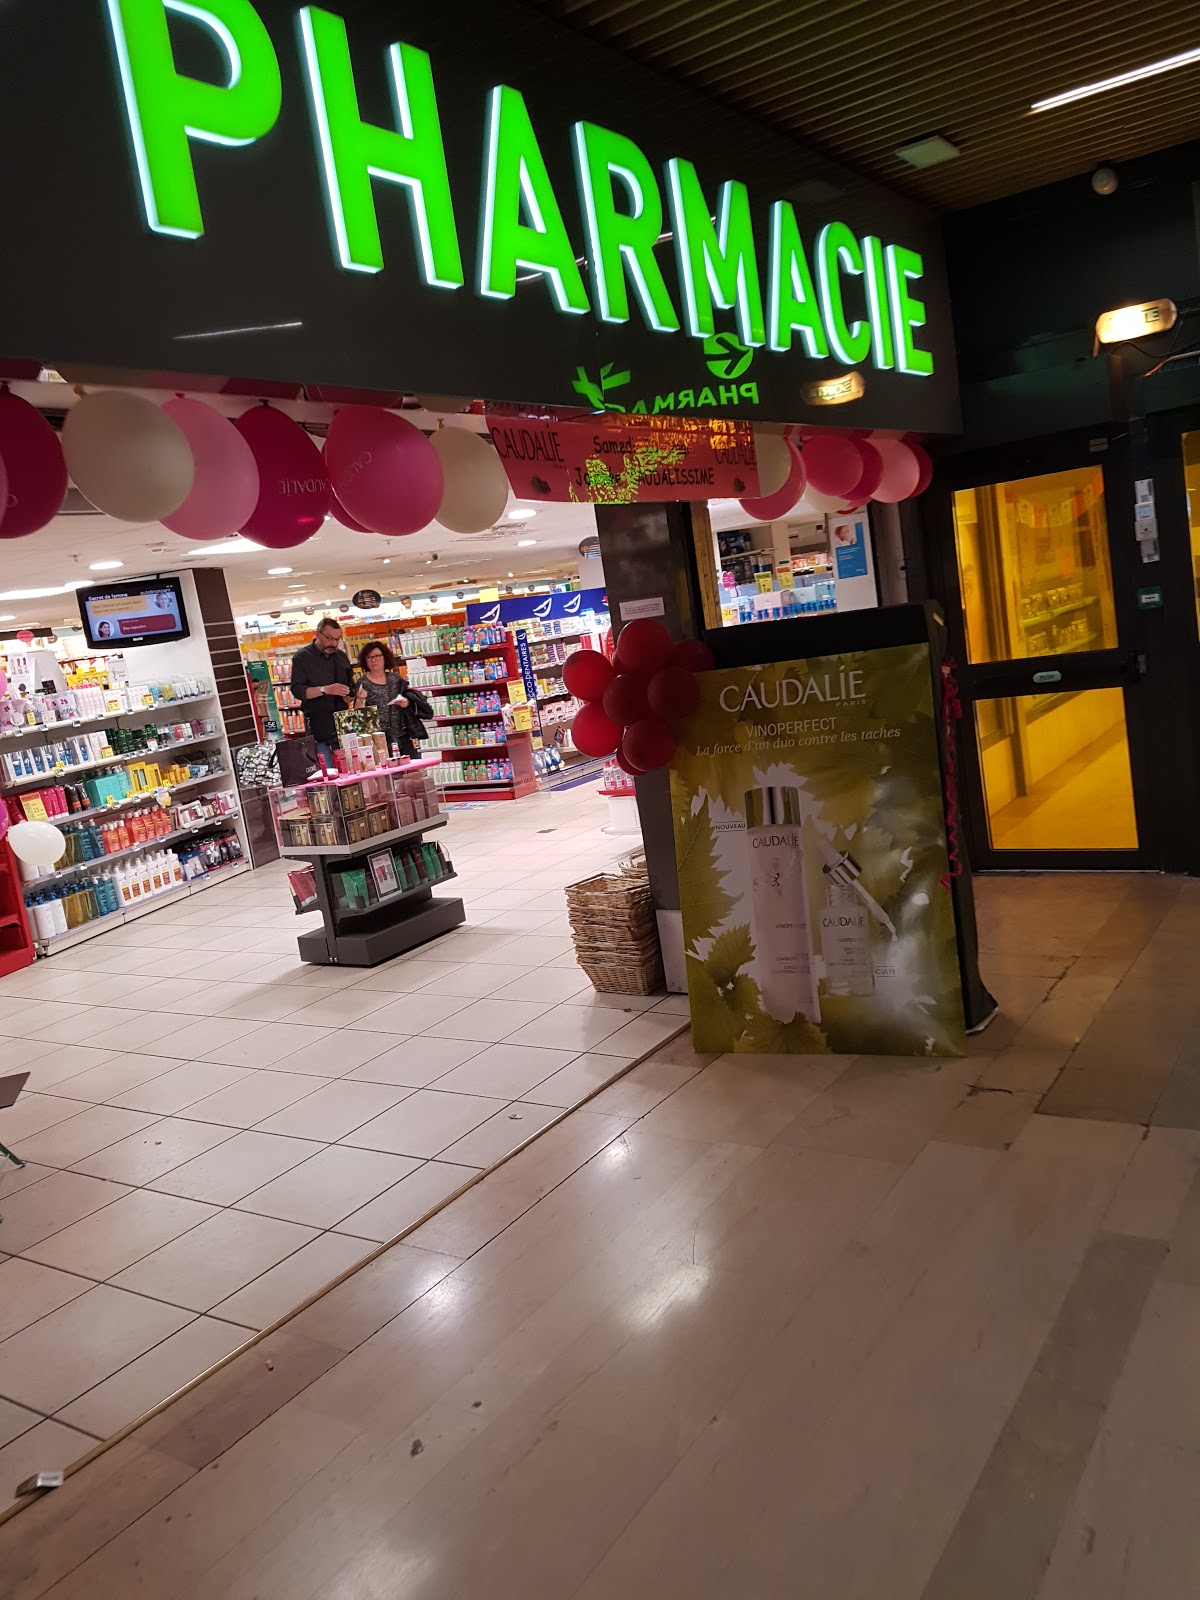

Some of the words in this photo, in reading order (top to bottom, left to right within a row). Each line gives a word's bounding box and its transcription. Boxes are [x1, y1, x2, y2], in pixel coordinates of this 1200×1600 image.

[107, 0, 934, 376] PHARMACIE
[629, 467, 715, 487] AUDALISSIME
[520, 642, 535, 700] CCO-DENTAIRES
[836, 699, 867, 708] PARIS
[745, 717, 837, 738] VINOPERFECT
[695, 744, 710, 757] La
[711, 742, 741, 757] force
[744, 740, 769, 752] d'un
[772, 737, 795, 749] duo
[798, 733, 837, 747] contre
[840, 730, 857, 742] les
[861, 727, 901, 741] taches
[715, 822, 746, 831] NOUVEAU
[875, 968, 896, 976] CULTE
